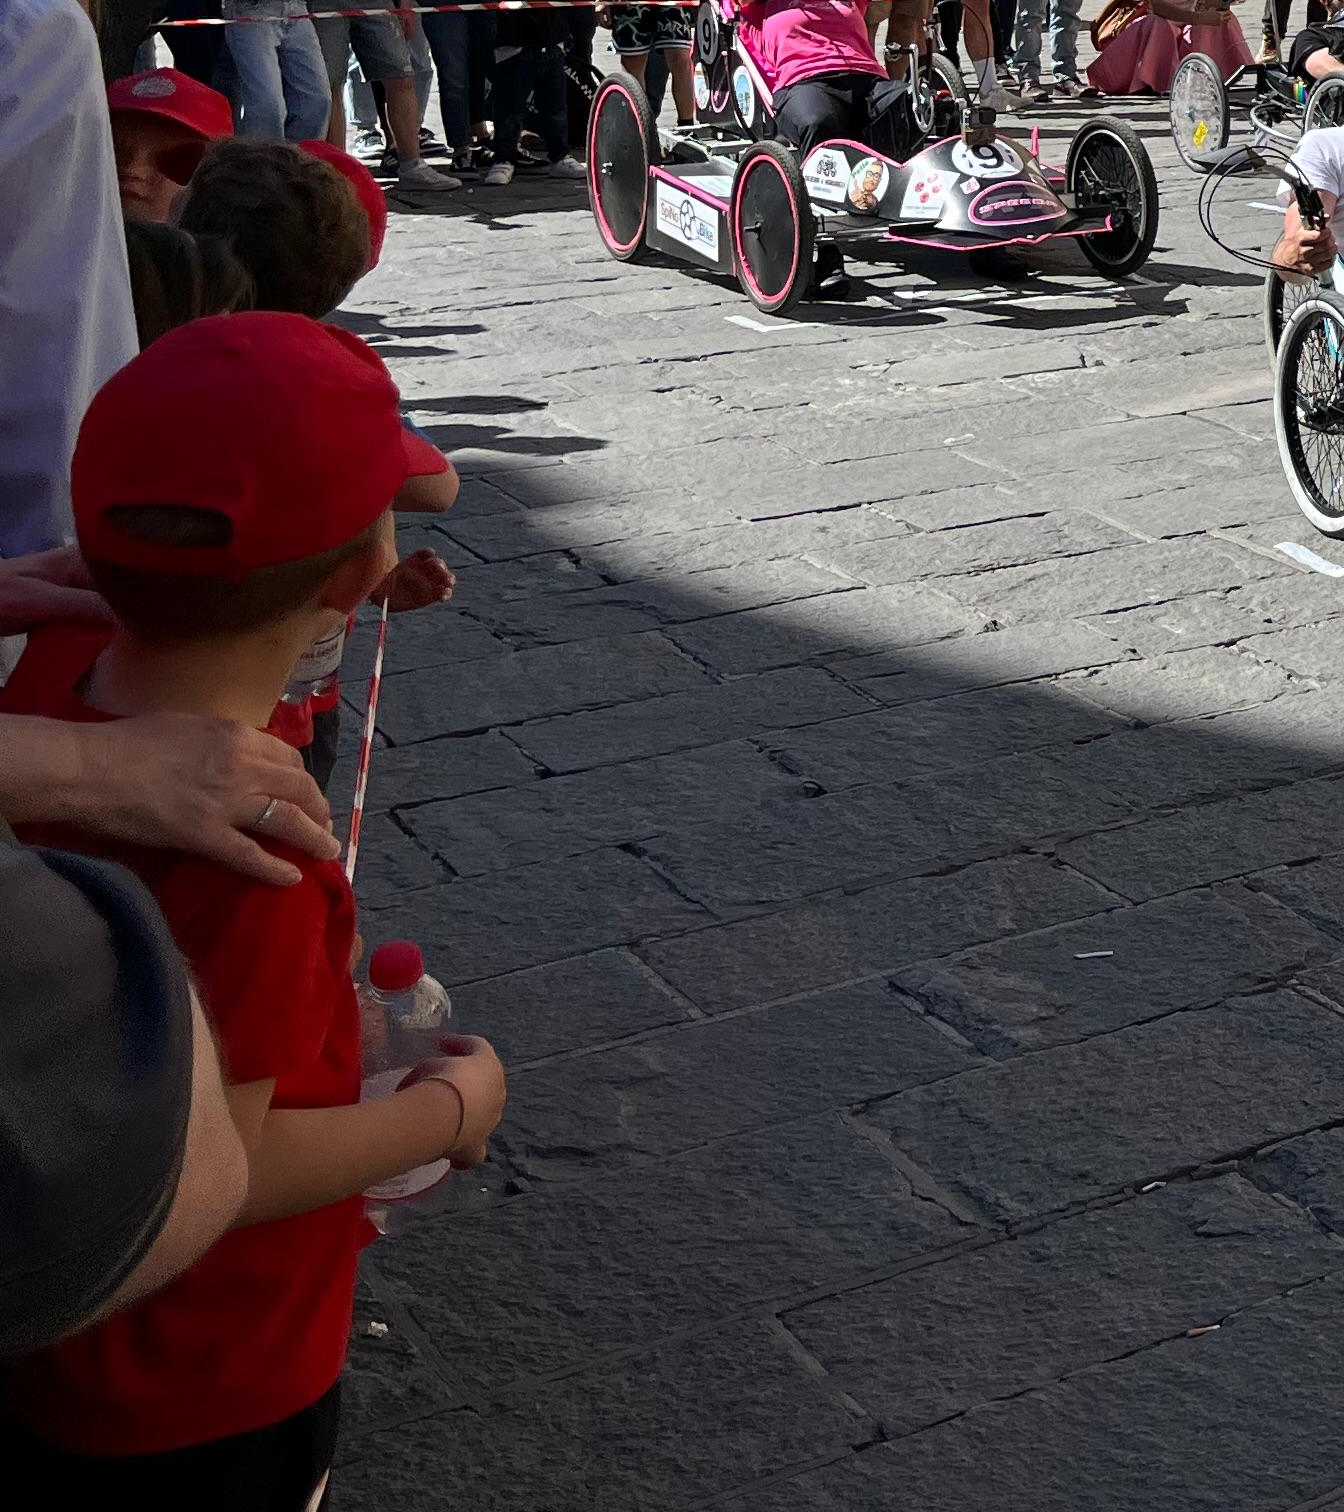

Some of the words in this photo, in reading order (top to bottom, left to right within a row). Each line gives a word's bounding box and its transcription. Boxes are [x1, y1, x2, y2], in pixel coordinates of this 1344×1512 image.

[703, 18, 712, 55] 9
[971, 144, 1004, 169] 9
[699, 223, 714, 242] Bike
